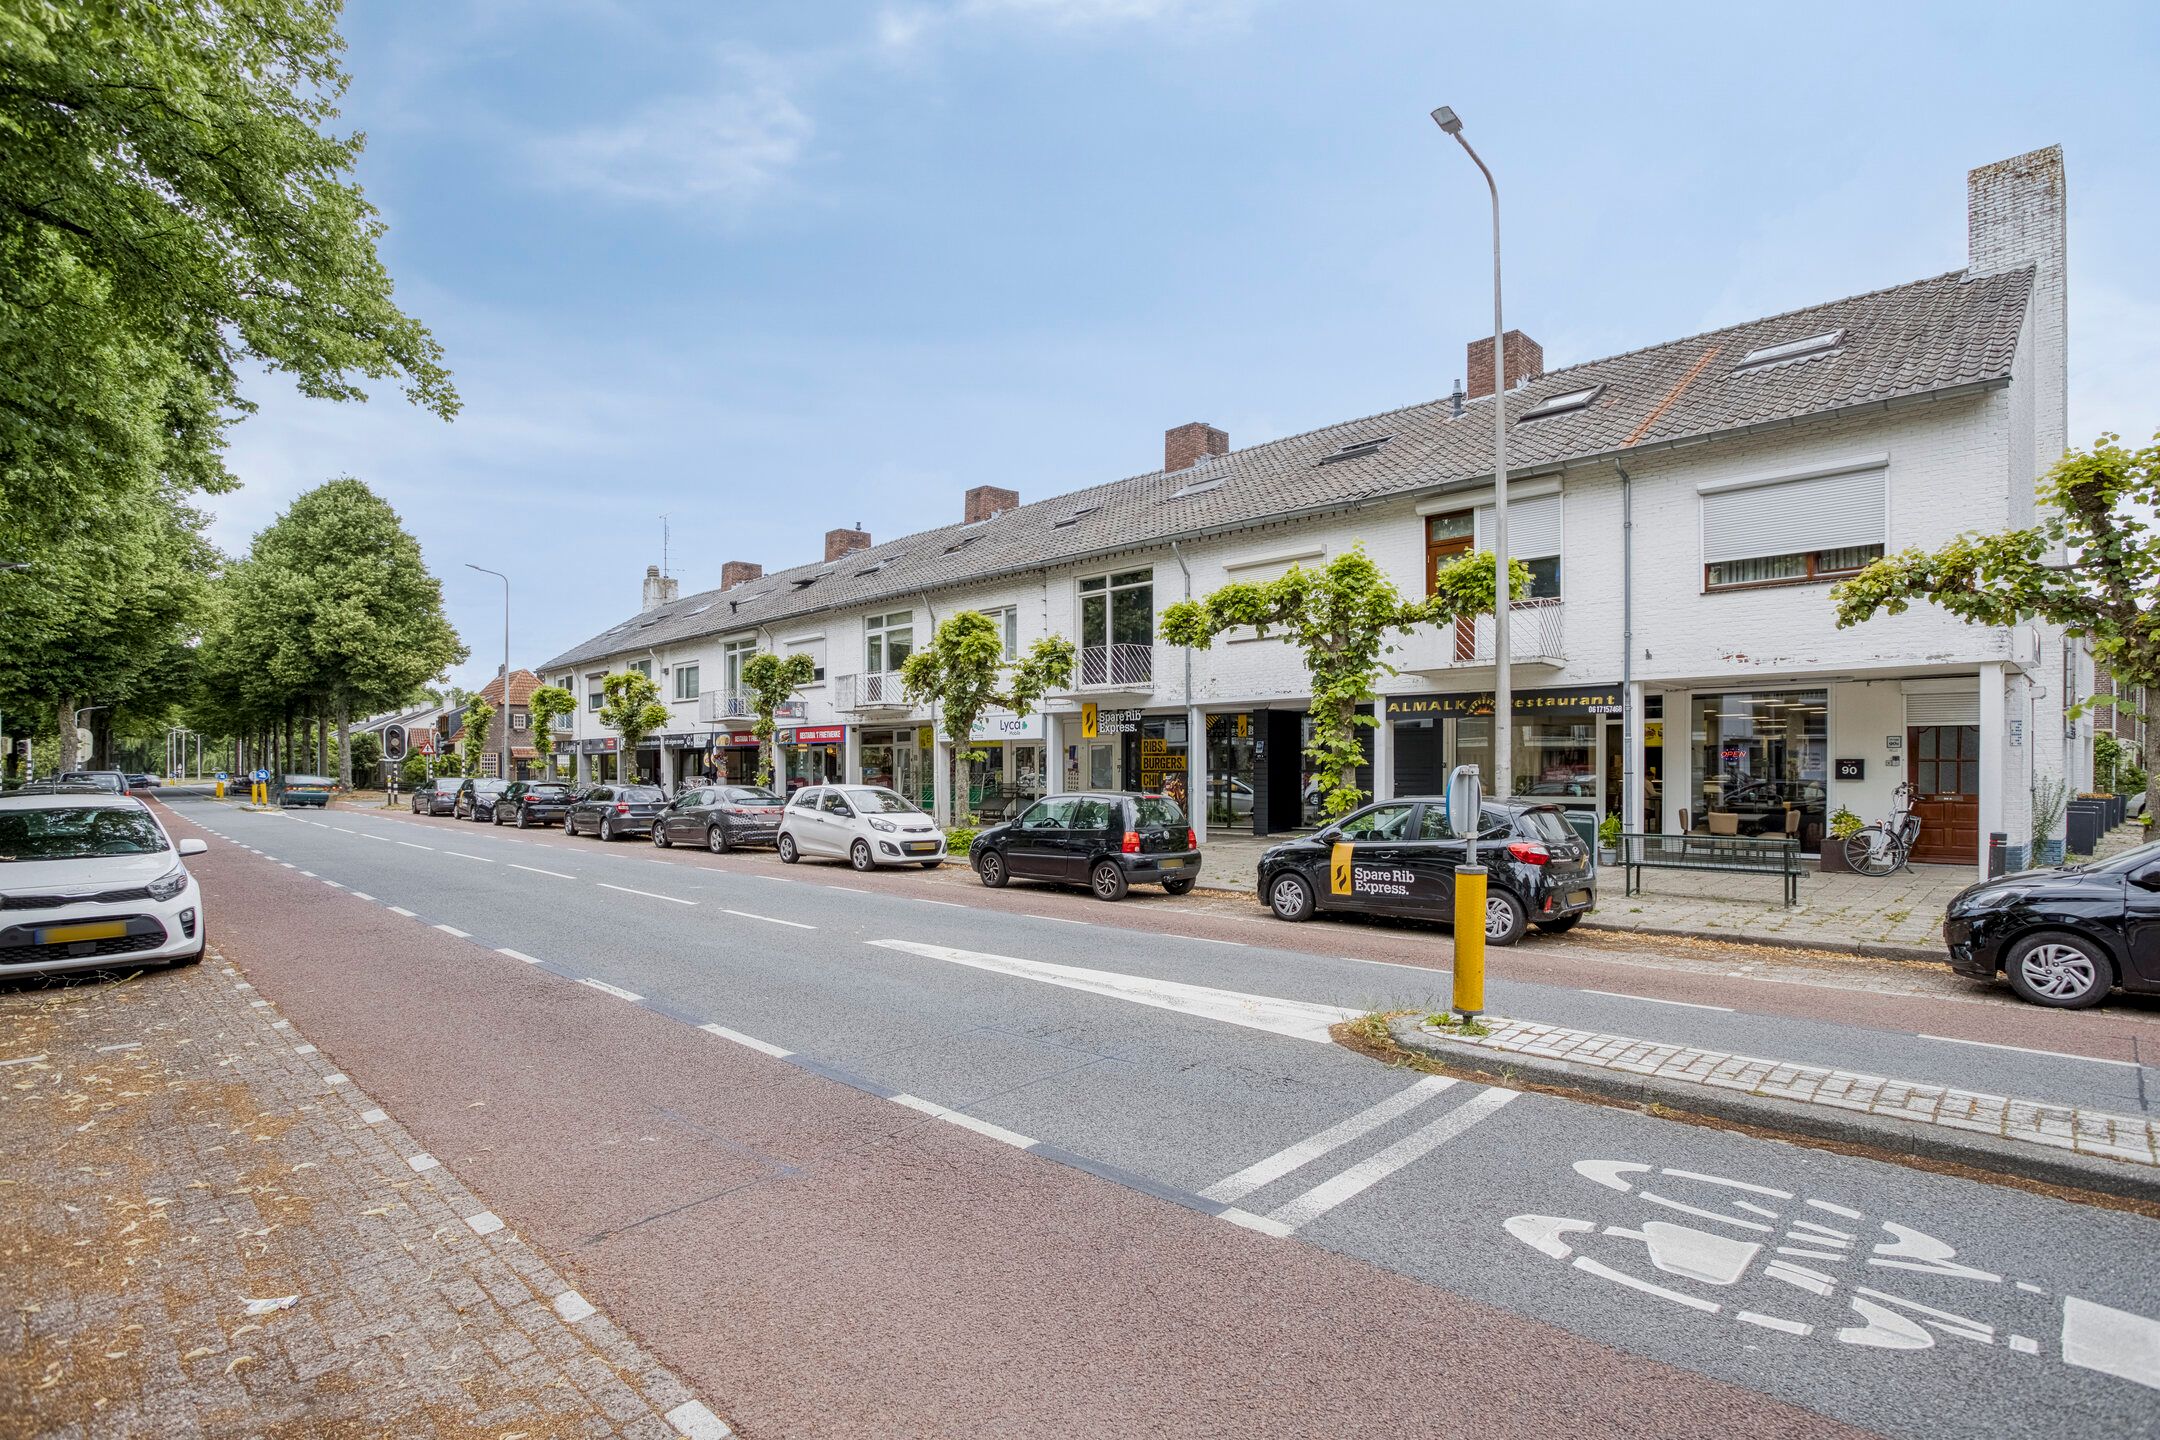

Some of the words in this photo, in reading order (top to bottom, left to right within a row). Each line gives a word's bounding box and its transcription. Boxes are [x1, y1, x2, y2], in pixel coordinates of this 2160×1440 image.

[1387, 700, 1466, 712] ALMALK
[1512, 695, 1615, 708] estaurant
[1099, 712, 1124, 724] Spare
[1125, 710, 1141, 721] Rib
[1000, 720, 1020, 732] Lyca
[1099, 722, 1137, 734] Express.
[1143, 740, 1165, 752] RIBS.
[1143, 757, 1185, 769] BURGERS.
[1841, 766, 1857, 775] 90
[1354, 867, 1391, 881] Spare
[1392, 870, 1415, 883] Rib
[1355, 880, 1409, 895] Express.
